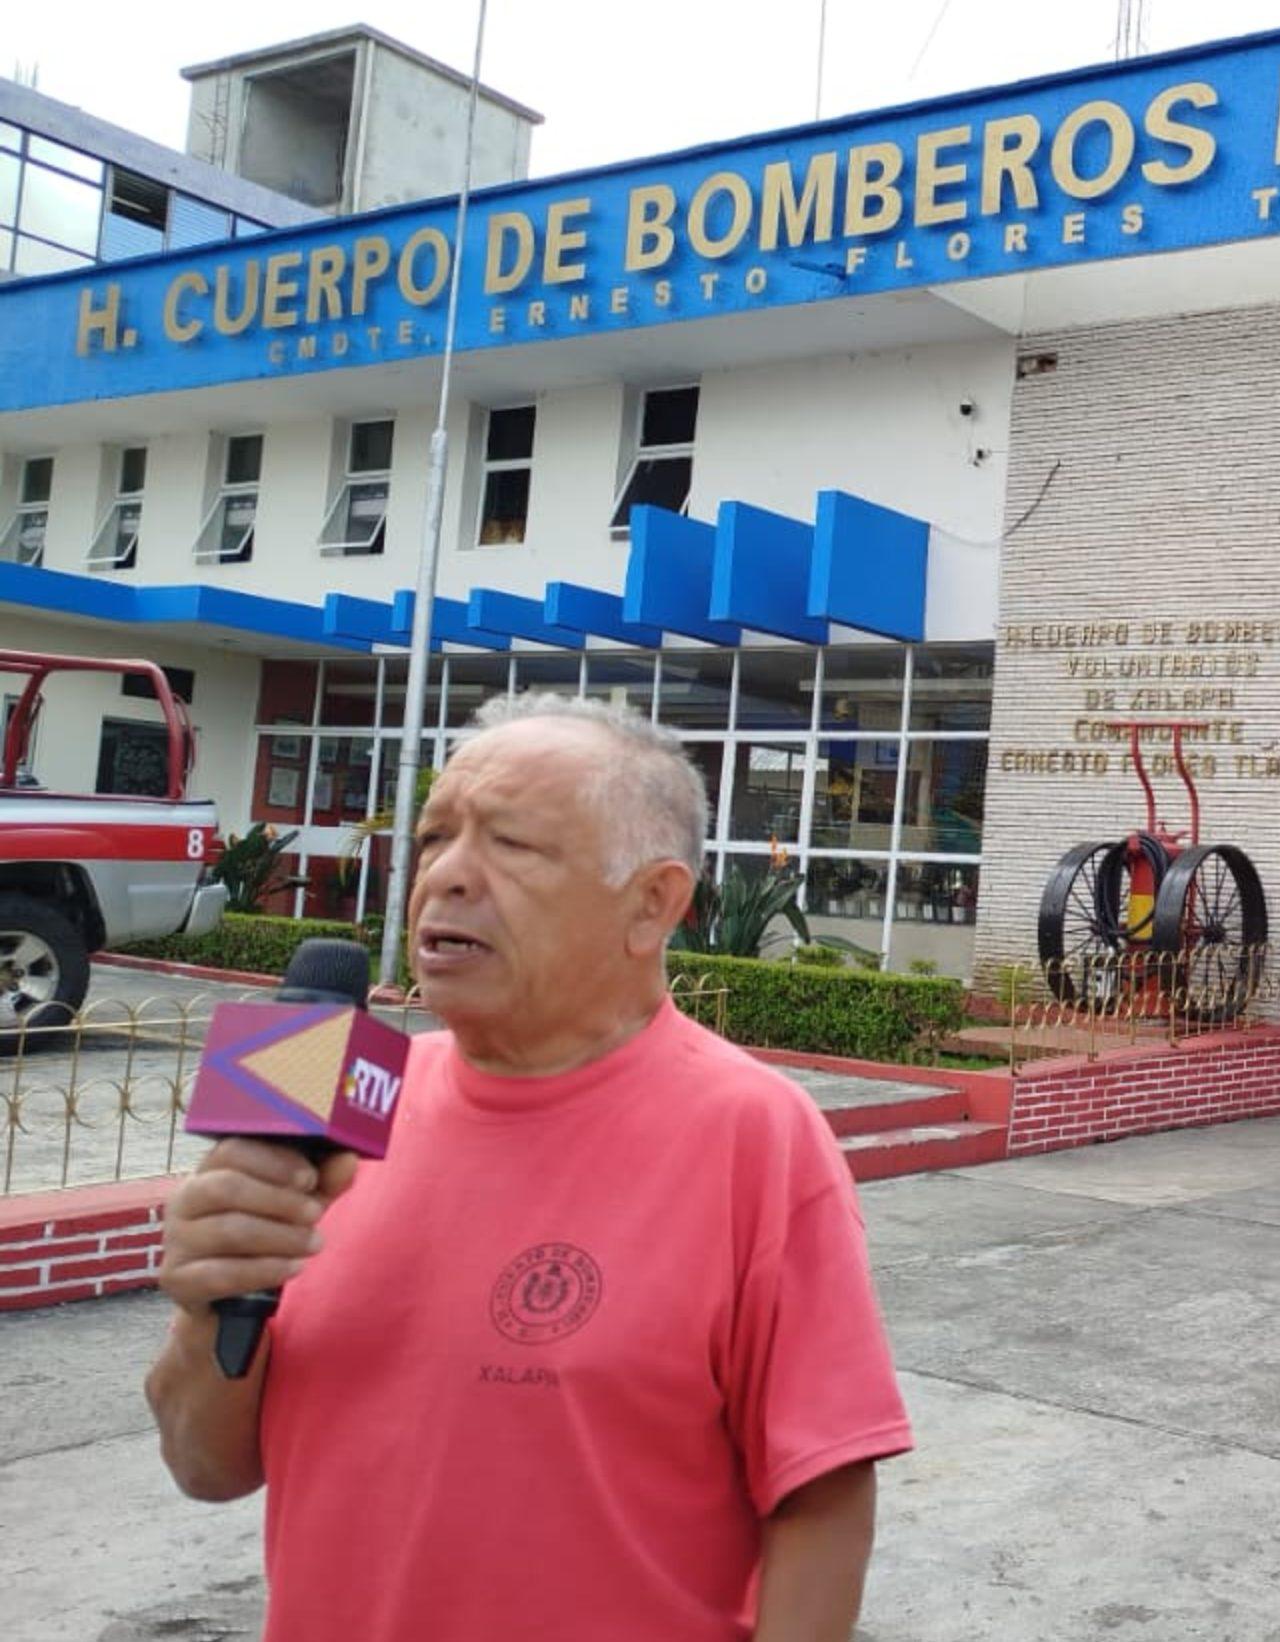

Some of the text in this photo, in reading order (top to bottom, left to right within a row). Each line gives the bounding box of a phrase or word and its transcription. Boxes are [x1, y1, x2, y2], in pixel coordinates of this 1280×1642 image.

[75, 284, 137, 358] H.
[163, 226, 452, 344] CUERPO
[483, 199, 592, 295] DE
[624, 82, 1220, 272] BOMBEROS
[489, 267, 767, 333] ERNESTO
[846, 205, 1144, 275] FLORES
[186, 829, 205, 859] 8
[351, 1056, 400, 1115] RTV
